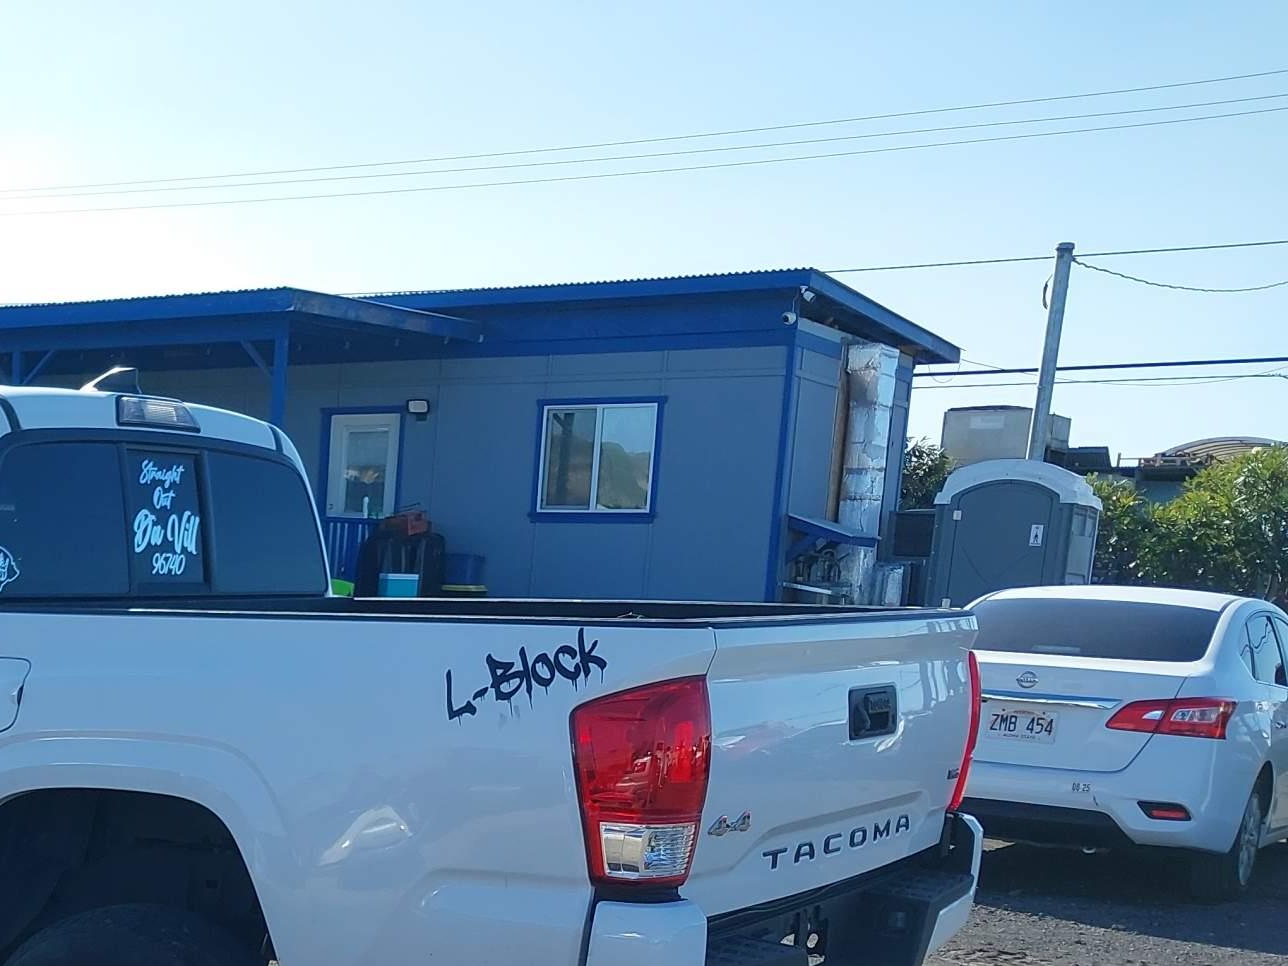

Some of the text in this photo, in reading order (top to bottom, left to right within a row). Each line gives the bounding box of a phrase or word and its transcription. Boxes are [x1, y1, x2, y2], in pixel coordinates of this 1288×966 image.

[140, 460, 185, 488] Straight
[153, 486, 176, 510] Out
[152, 553, 186, 575] 96740
[990, 713, 1054, 736] ZMB 454
[762, 813, 910, 870] TACOMA
